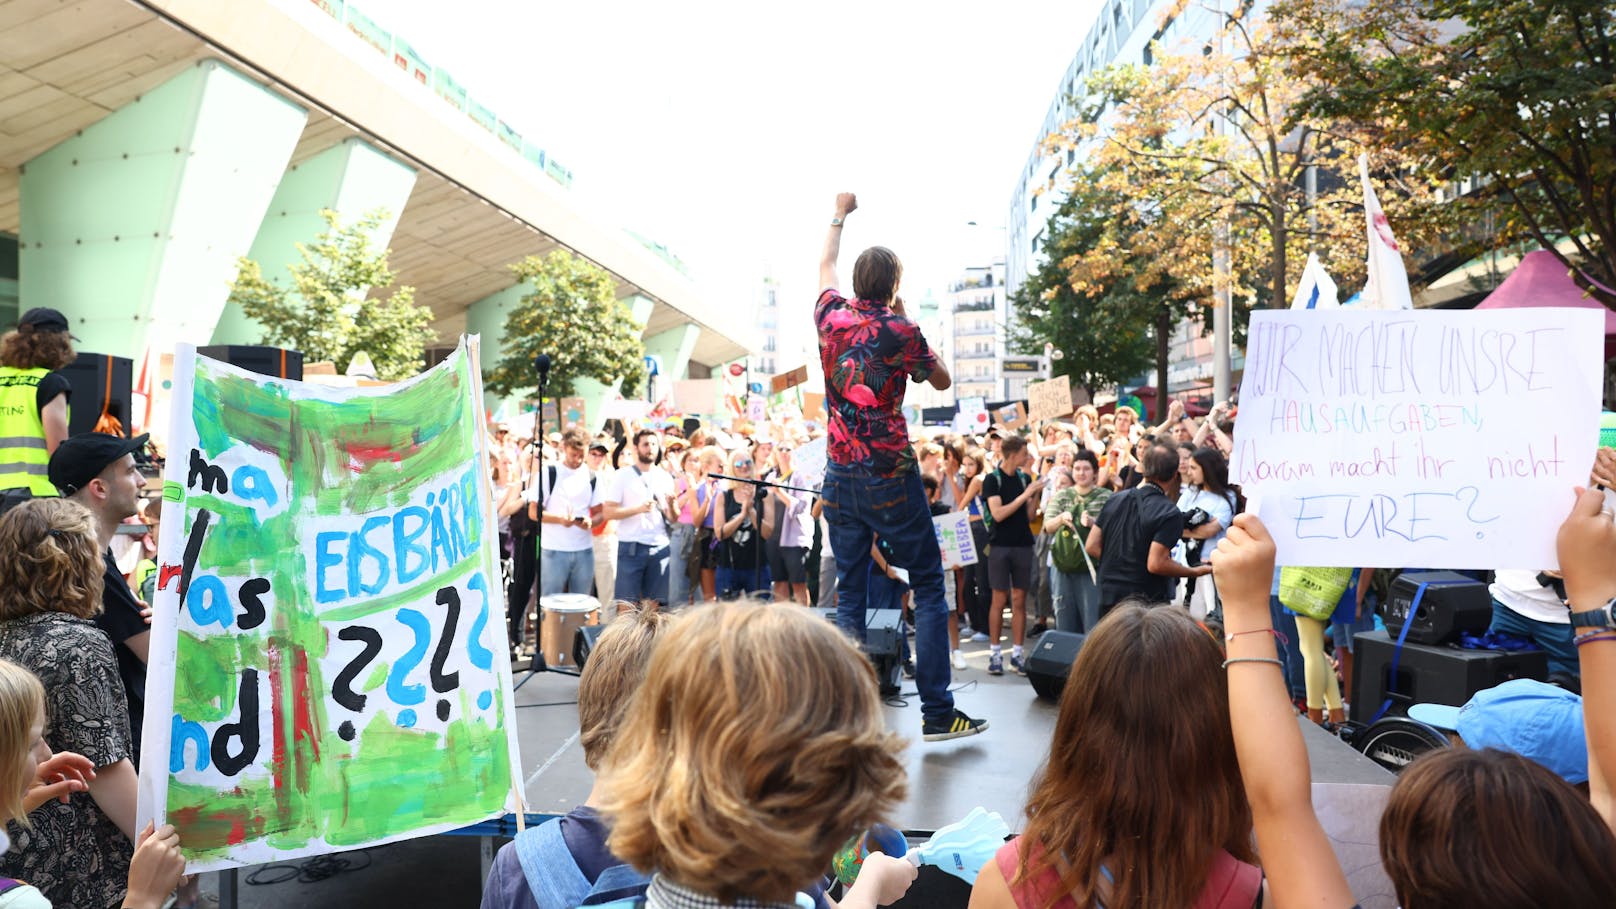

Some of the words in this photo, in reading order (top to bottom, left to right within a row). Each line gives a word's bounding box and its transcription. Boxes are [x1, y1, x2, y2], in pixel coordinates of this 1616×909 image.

[1252, 321, 1309, 397] WIR
[1319, 320, 1421, 400] MACHEN
[1439, 325, 1565, 396] UNSRE
[1270, 399, 1484, 434] HAUSAUFGABEN,
[1330, 439, 1399, 477] macht
[1416, 435, 1456, 480] ihr
[1487, 434, 1565, 479] nicht
[315, 460, 482, 604] EISBÄRE
[954, 518, 975, 562] FIEBER
[1294, 486, 1501, 543] EURE?
